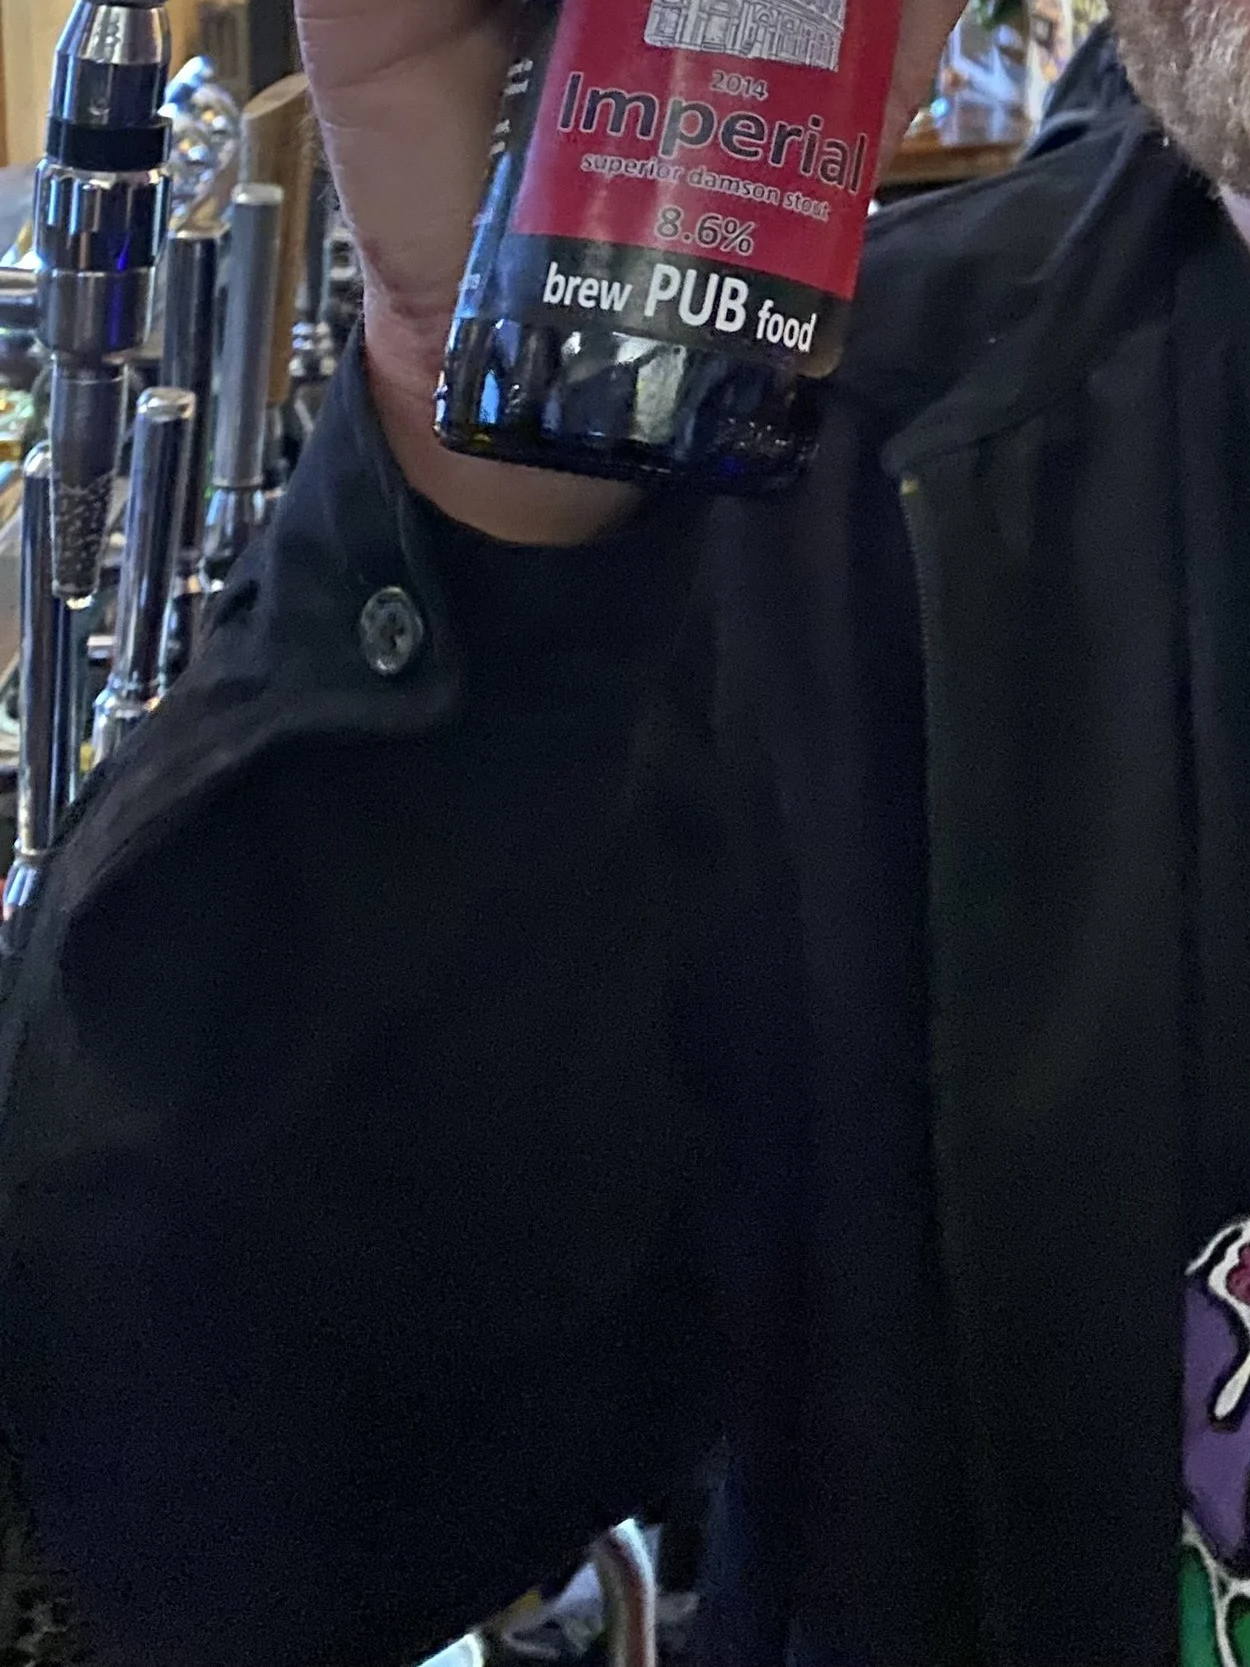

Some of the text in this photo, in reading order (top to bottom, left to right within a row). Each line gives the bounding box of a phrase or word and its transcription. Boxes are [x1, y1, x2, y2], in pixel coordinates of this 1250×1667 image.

[710, 70, 769, 102] 2014
[558, 70, 869, 197] Imperial
[580, 151, 833, 223] superior damson stout
[654, 205, 755, 256] 8.6%
[541, 261, 818, 354] brew PUB food
